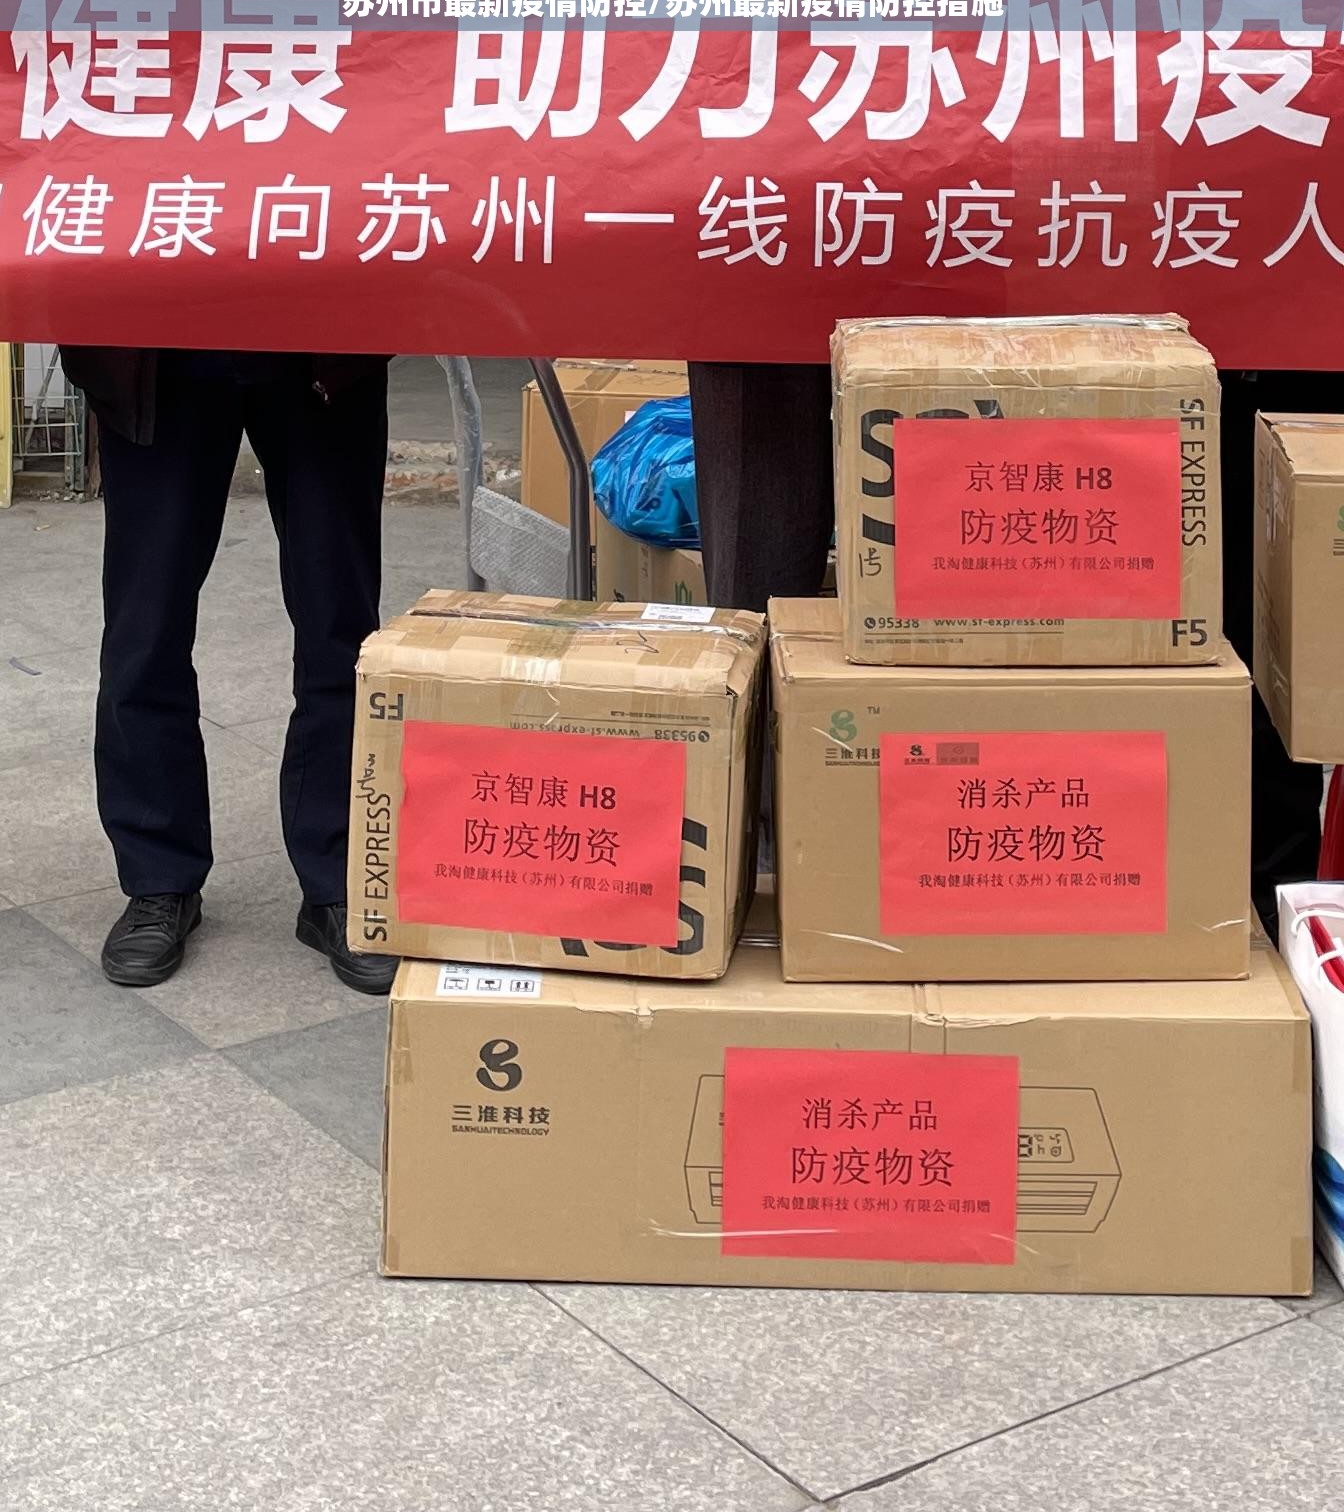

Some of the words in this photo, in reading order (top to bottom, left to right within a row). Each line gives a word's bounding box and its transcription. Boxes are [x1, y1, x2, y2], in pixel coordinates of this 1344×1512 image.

[1179, 398, 1205, 431] SF
[964, 461, 1065, 493] 京智康
[1075, 467, 1113, 491] H8
[1181, 441, 1206, 547] EXPRESS
[960, 507, 1120, 546] 防疫物资
[878, 617, 920, 629] 95338
[1171, 619, 1208, 648] F5
[369, 692, 404, 721] F5
[470, 770, 570, 810] 京智康
[579, 784, 617, 811] H8
[956, 777, 1091, 810] 消杀产品
[365, 793, 391, 900] EXPRESS
[463, 817, 621, 867] 防疫物资
[947, 824, 1106, 863] 防疫物资
[363, 908, 388, 942] SF
[802, 1097, 938, 1131] 消杀产品
[791, 1145, 955, 1187] 防疫物资
